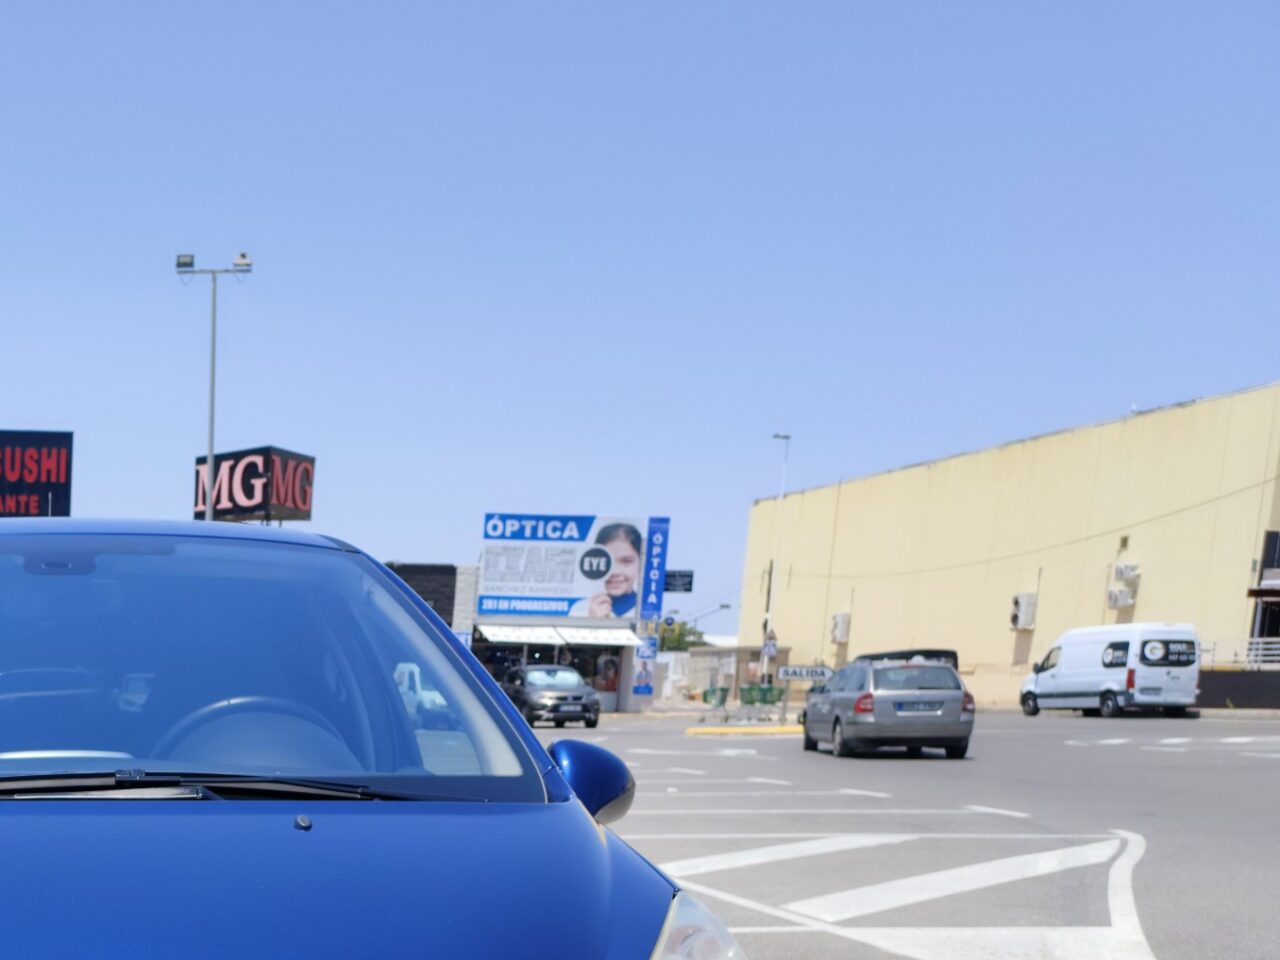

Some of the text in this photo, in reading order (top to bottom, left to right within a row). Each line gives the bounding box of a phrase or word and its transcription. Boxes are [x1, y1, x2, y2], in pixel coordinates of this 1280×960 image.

[194, 455, 268, 512] MG
[270, 455, 312, 512] MG
[486, 515, 580, 539] ÓPTICA
[582, 556, 608, 572] EYE
[782, 668, 826, 678] SALIDA
